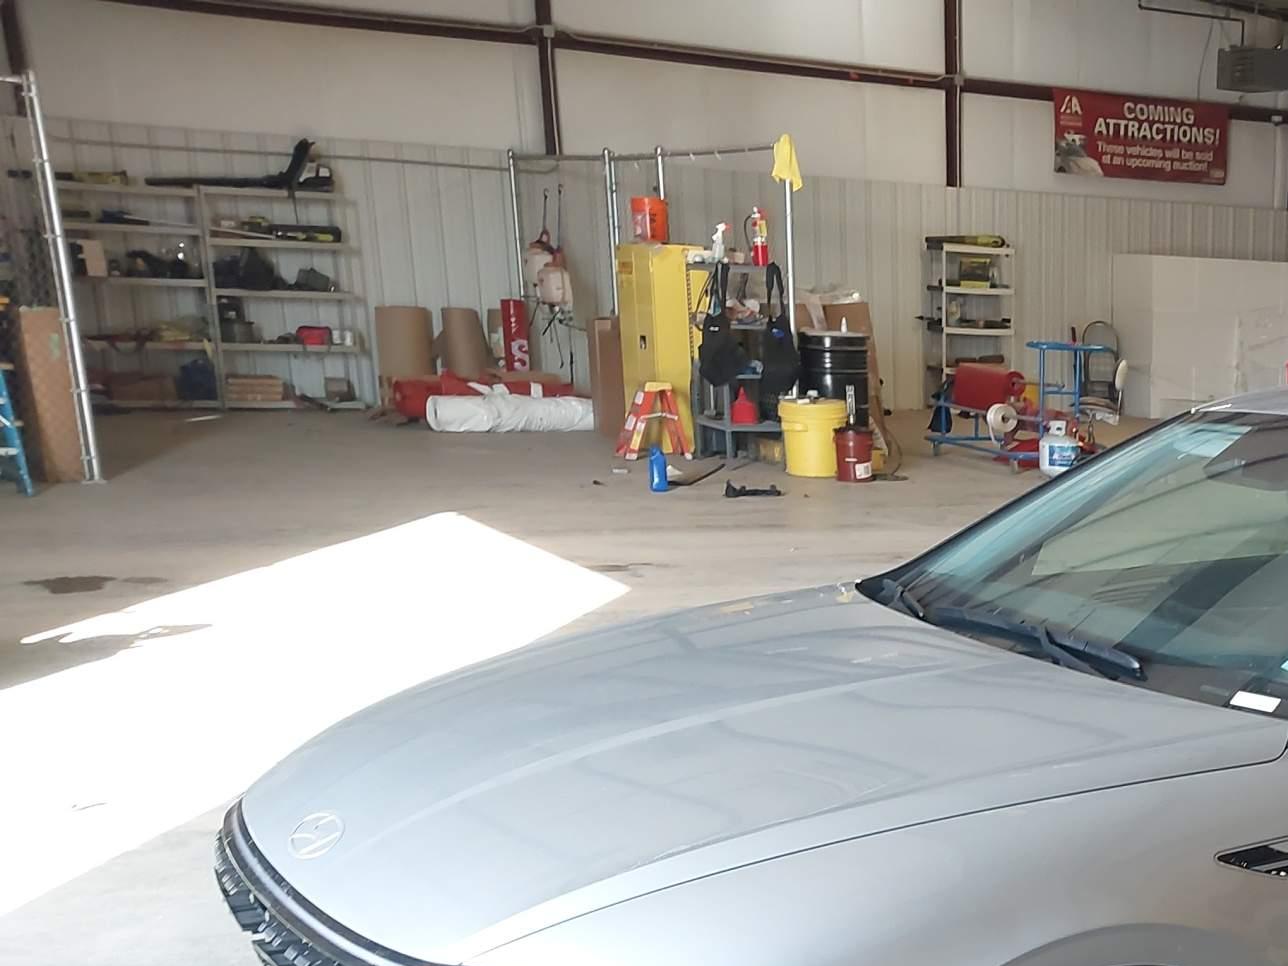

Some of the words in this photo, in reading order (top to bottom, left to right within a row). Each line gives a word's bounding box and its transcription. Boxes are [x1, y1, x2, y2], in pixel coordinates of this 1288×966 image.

[1123, 102, 1195, 124] COMING
[1094, 117, 1220, 145] ATTRACTIONS!
[1096, 141, 1125, 155] These
[1126, 144, 1164, 158] vehicles
[1165, 147, 1181, 159] will
[1181, 149, 1193, 160] be
[1195, 150, 1214, 161] sold
[1102, 154, 1111, 165] at
[1112, 156, 1125, 165] an
[1126, 157, 1172, 171] upcoming
